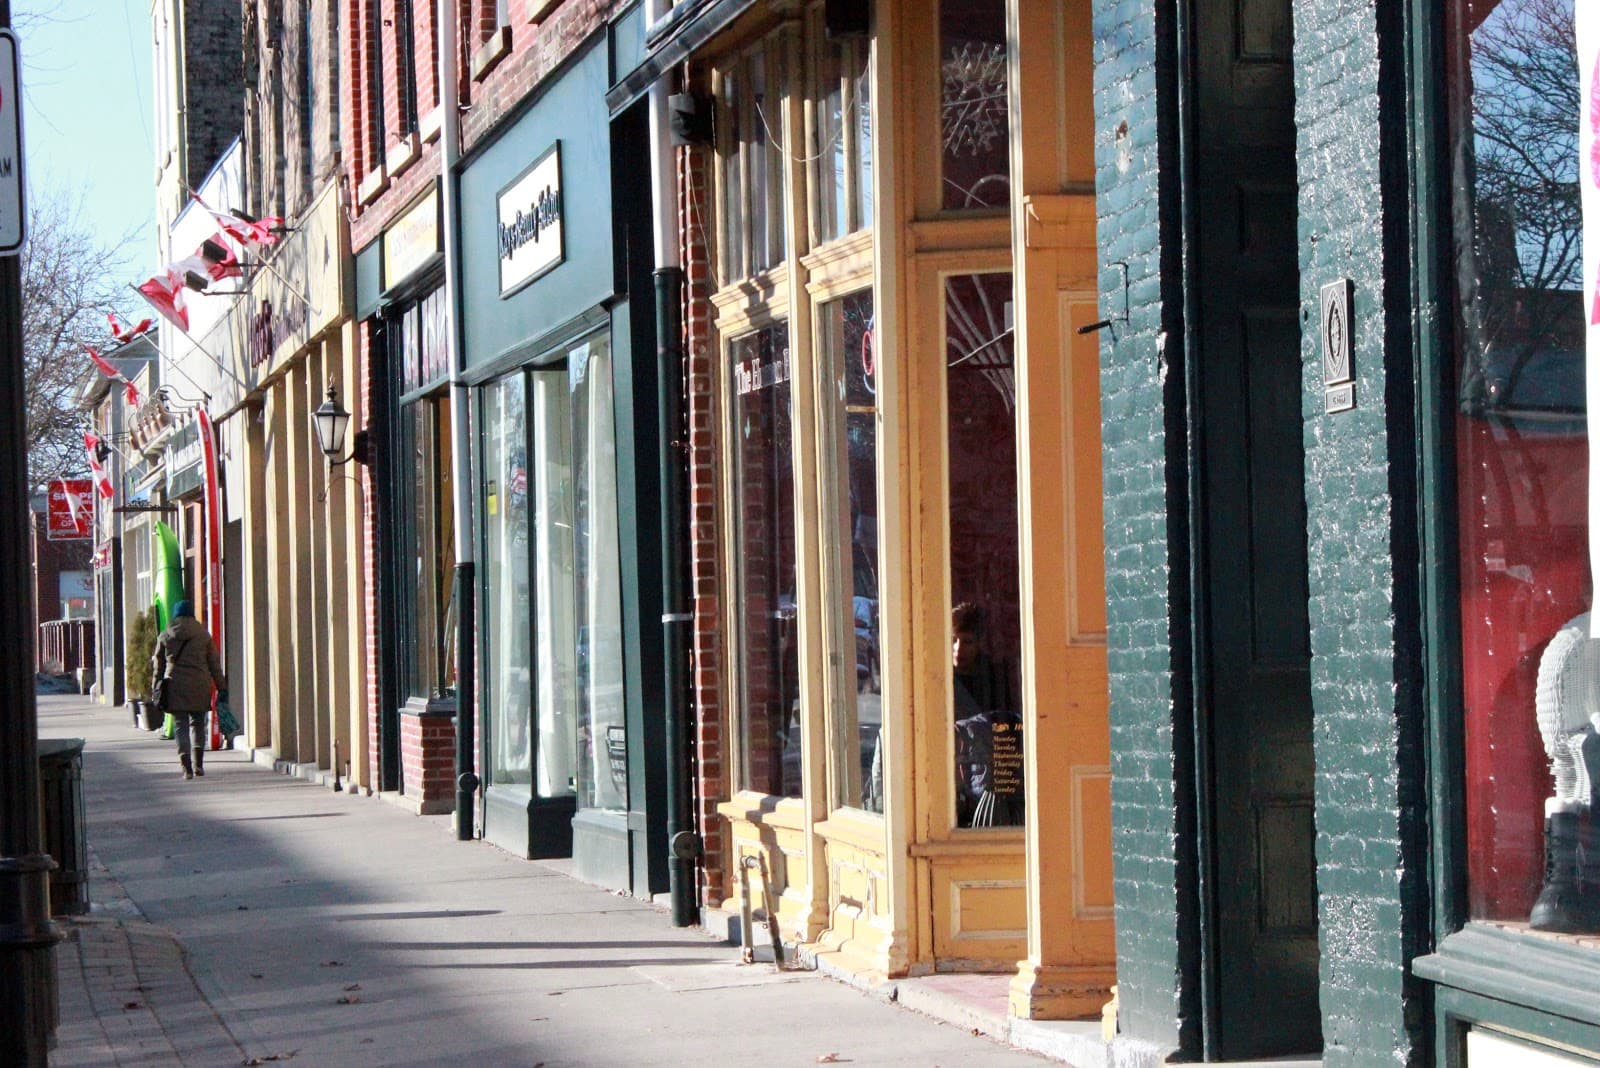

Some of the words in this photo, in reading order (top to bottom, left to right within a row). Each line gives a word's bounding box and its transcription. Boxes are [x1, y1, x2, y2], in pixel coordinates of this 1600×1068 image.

[735, 361, 751, 395] The
[993, 735, 1016, 743] Monday
[993, 761, 1020, 769] Thursday
[993, 769, 1013, 777] Friday
